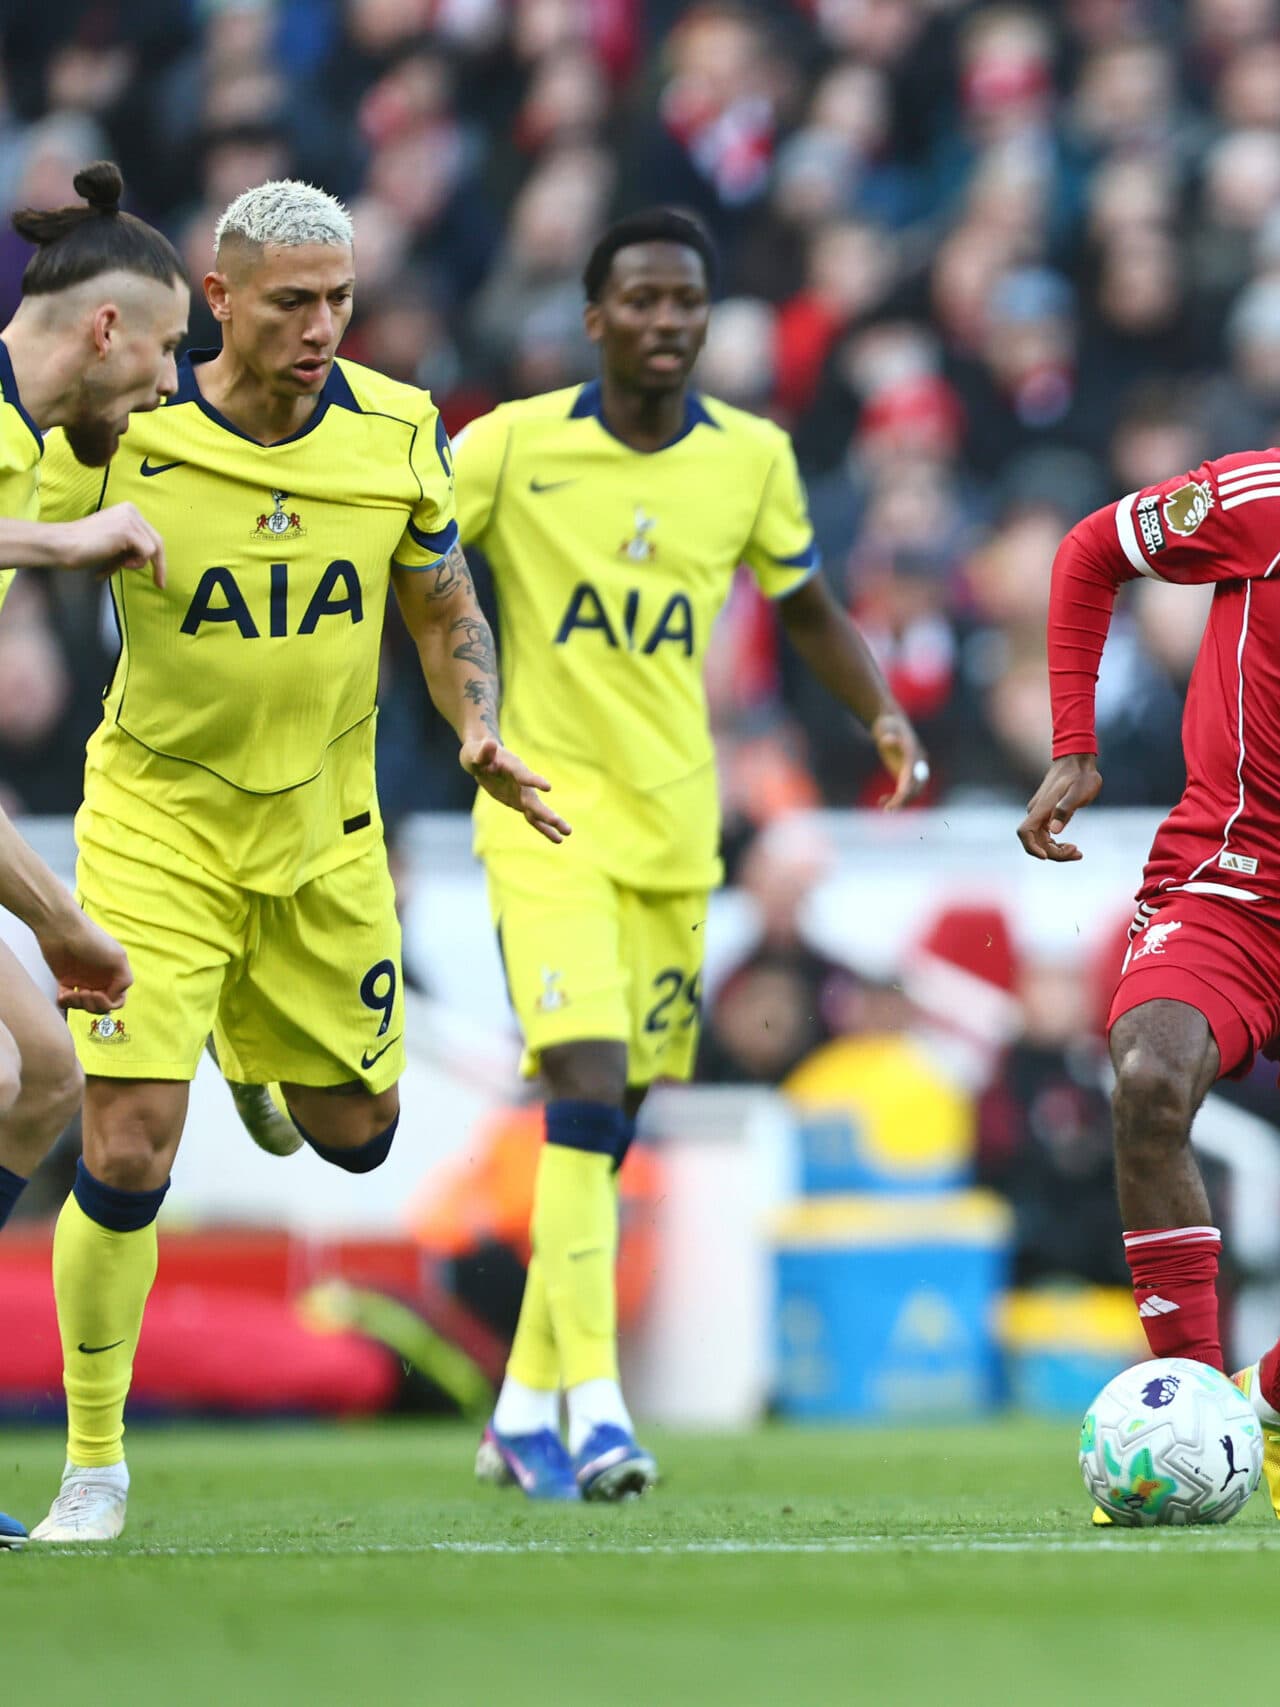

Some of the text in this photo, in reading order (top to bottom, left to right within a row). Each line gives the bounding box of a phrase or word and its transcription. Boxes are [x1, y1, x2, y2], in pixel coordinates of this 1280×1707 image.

[1147, 510, 1164, 547] room
[179, 559, 364, 639] AIA
[554, 580, 694, 658] AIA
[360, 958, 396, 1037] 9
